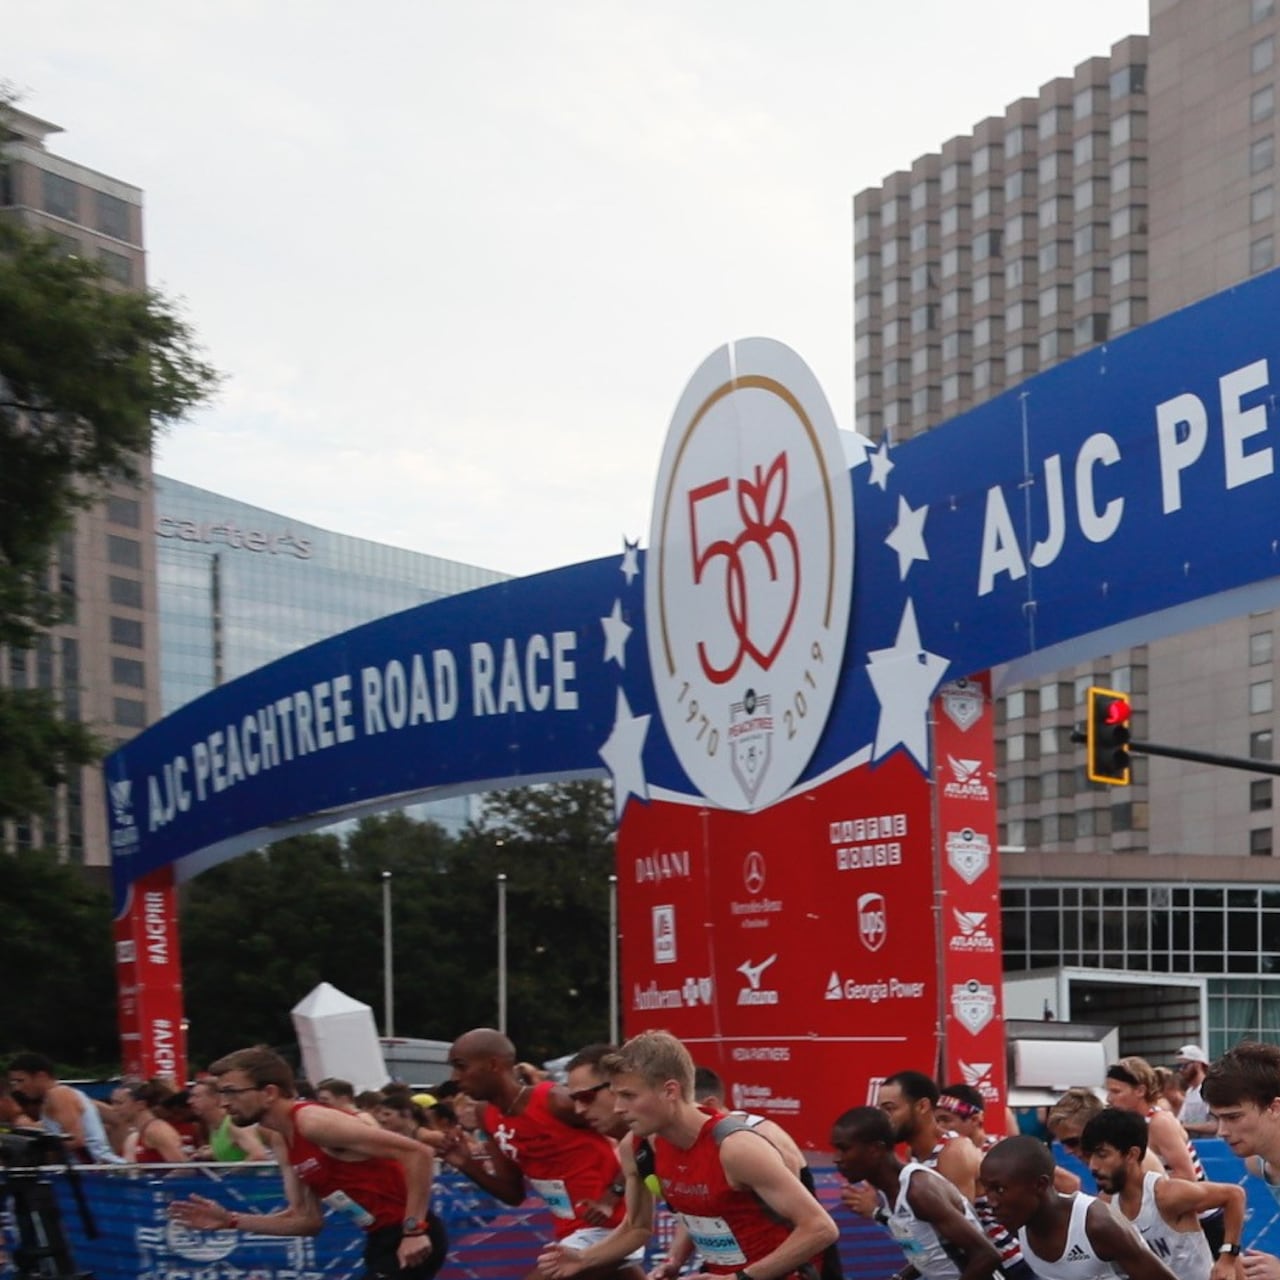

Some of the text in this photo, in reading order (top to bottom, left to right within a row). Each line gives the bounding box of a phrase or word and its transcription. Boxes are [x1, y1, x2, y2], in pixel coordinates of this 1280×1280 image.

[155, 515, 313, 561] carter's
[979, 432, 1124, 596] AJC
[676, 682, 721, 758] 1970
[783, 641, 825, 741] 2019
[147, 631, 578, 833] AJC PEACHTREE ROAD RACE
[944, 782, 989, 796] ATLANTA
[837, 843, 901, 870] HOUSE
[144, 892, 169, 965] #AJCPRR
[949, 935, 995, 948] ATLANTA
[844, 977, 925, 1003] Georgia Power
